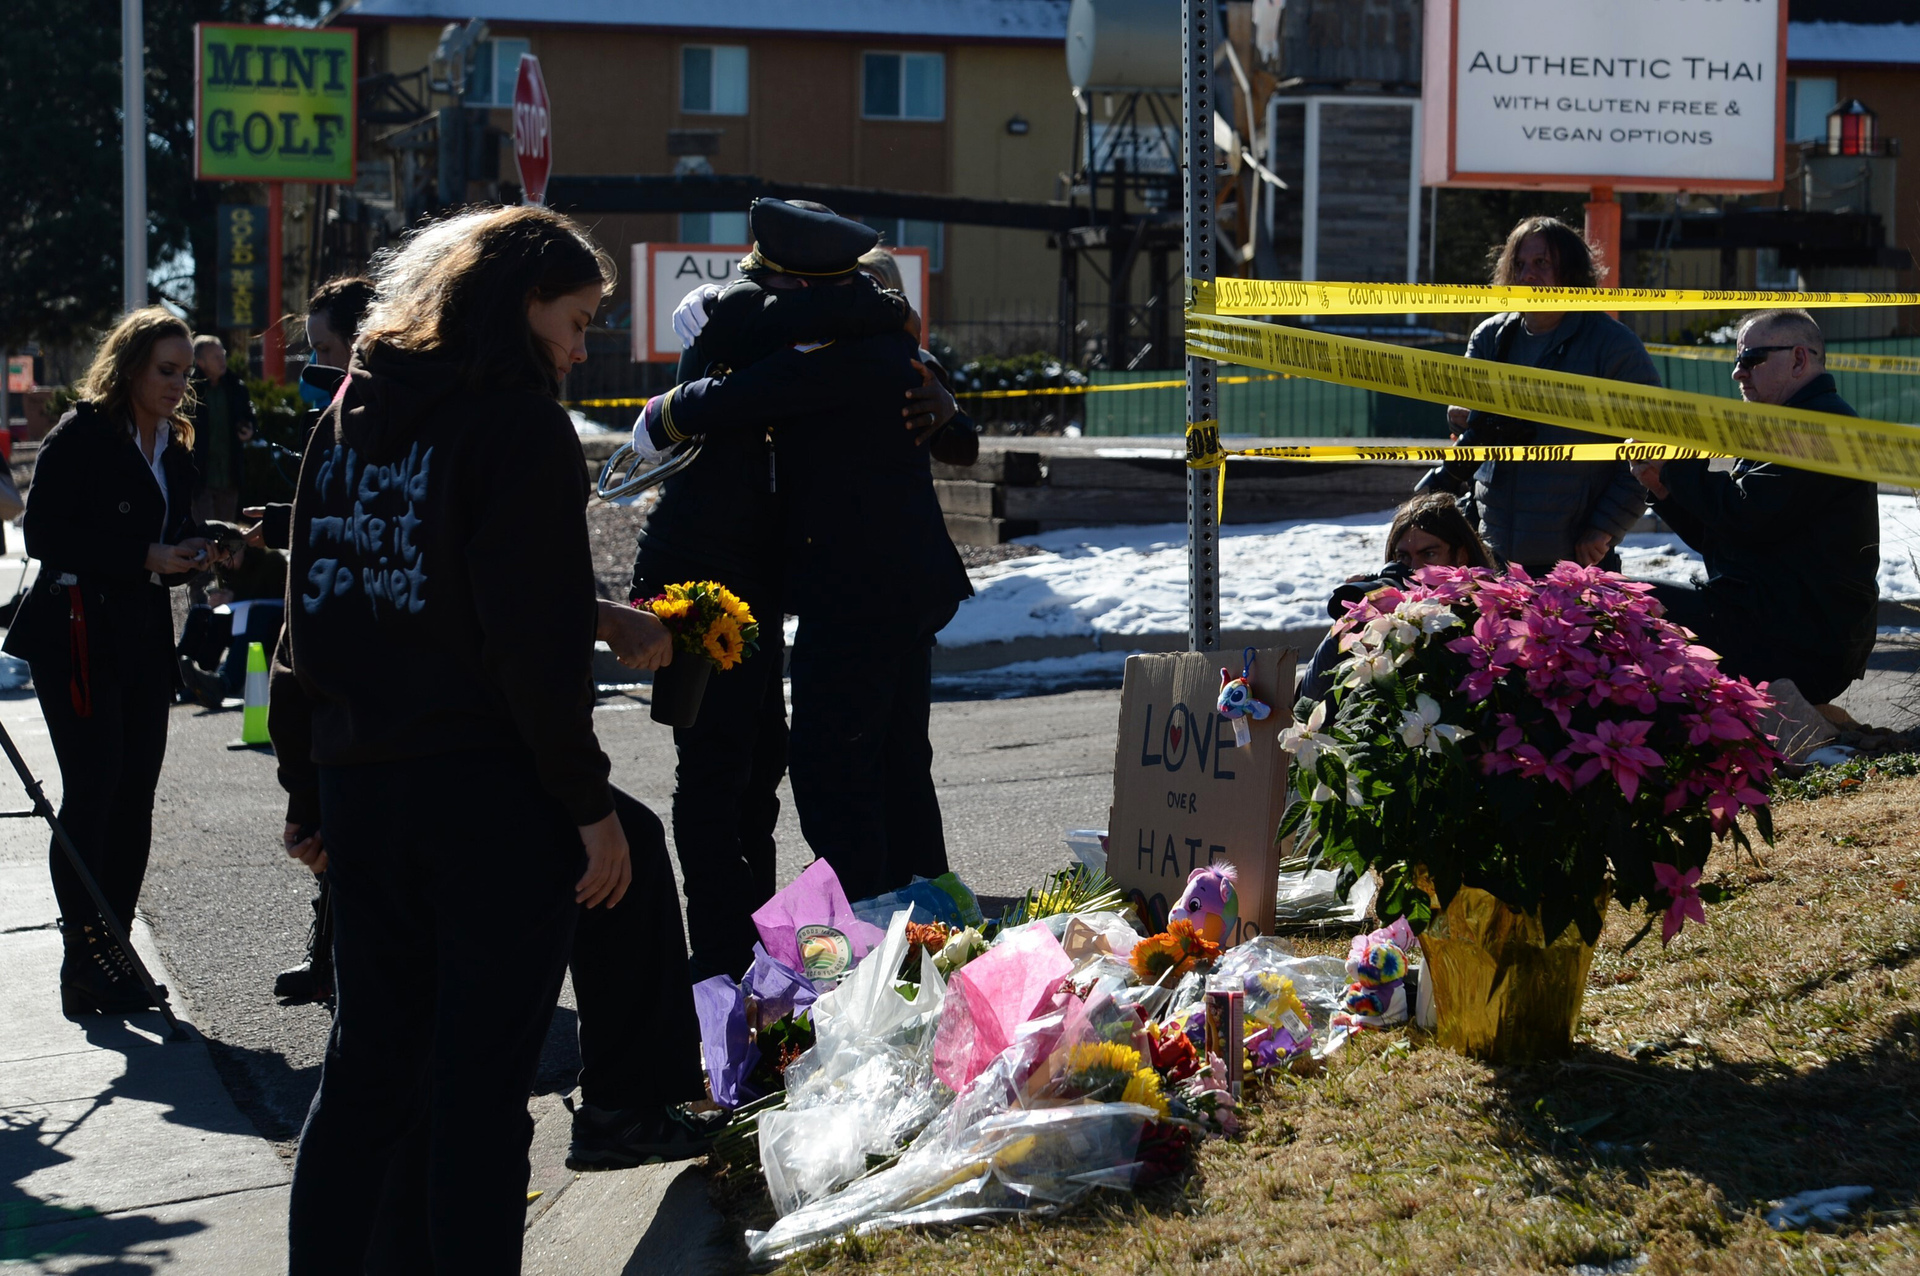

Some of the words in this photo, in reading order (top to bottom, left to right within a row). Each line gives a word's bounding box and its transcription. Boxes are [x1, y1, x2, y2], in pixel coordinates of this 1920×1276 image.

[207, 43, 346, 92] MINI
[1468, 51, 1671, 80] AUTHENTIC
[1683, 57, 1762, 82] THAI
[516, 102, 547, 158] STOP
[1494, 96, 1549, 112] WITH
[1557, 97, 1649, 114] GLUTEN
[1658, 100, 1717, 116] FREE
[1725, 101, 1741, 117] &
[207, 110, 344, 157] GOLF
[1522, 126, 1602, 143] VEGAN
[1610, 128, 1713, 145] OPTIONS
[358, 441, 434, 503] could
[309, 500, 386, 556] make
[392, 500, 423, 563] it
[302, 558, 354, 614] go
[363, 552, 428, 621] quiet
[1142, 703, 1235, 779] LOVE
[1166, 790, 1198, 814] OVER
[821, 930, 843, 944] MARKET
